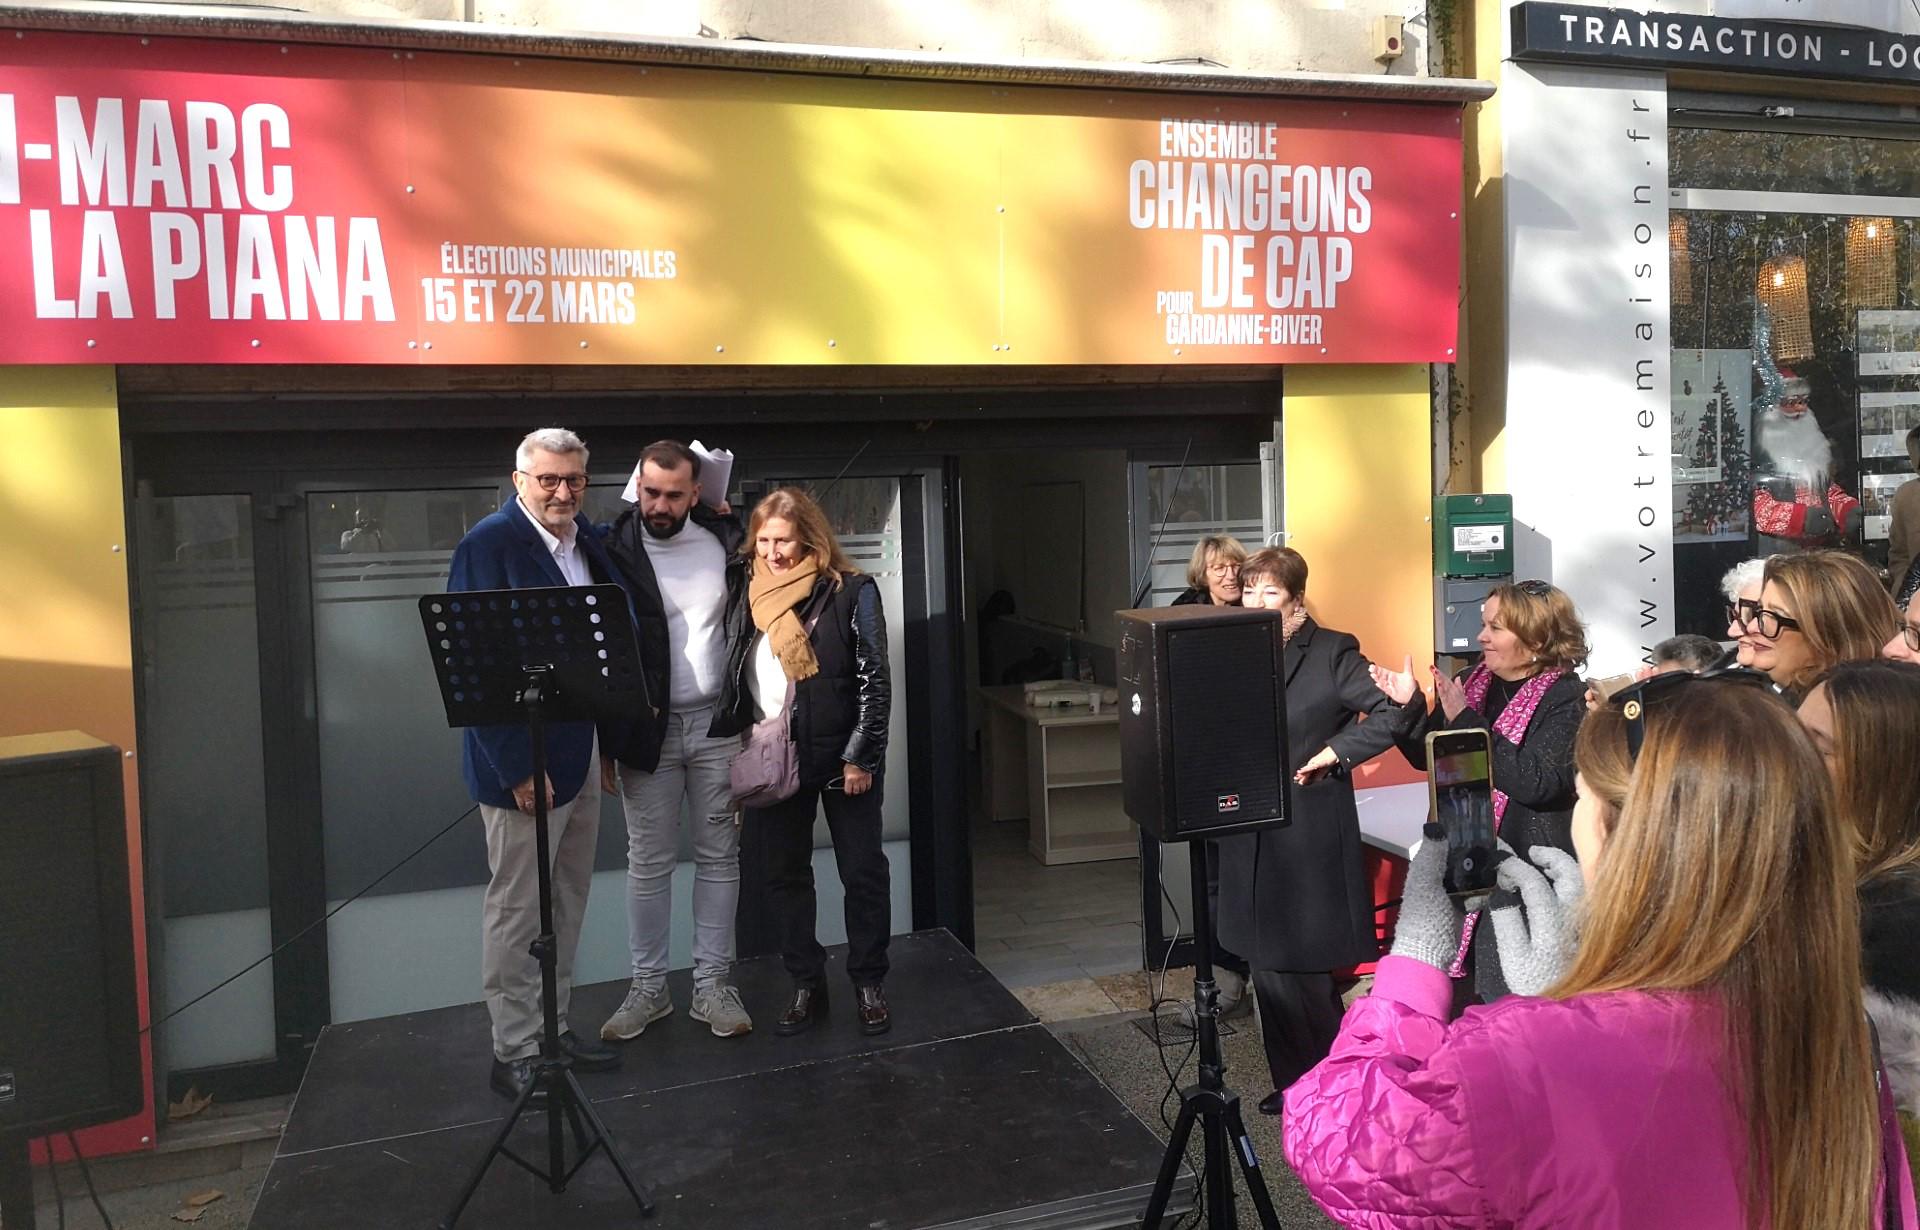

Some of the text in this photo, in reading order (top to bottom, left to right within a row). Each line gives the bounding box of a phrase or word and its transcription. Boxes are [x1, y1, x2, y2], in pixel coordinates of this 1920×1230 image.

[1559, 14, 1822, 61] TRANSACTION
[1160, 117, 1278, 160] ENSEMBLE
[1129, 159, 1372, 233] CHANGEONS
[29, 209, 396, 321] LA PIANA
[441, 241, 676, 279] ÉLECTIONS MUNICIPALES
[1201, 234, 1353, 308] DE CAP
[421, 277, 636, 325] 15 ET 22 MARS
[1156, 291, 1194, 315] POUR
[1166, 314, 1322, 345] GARDANNE-BIVER
